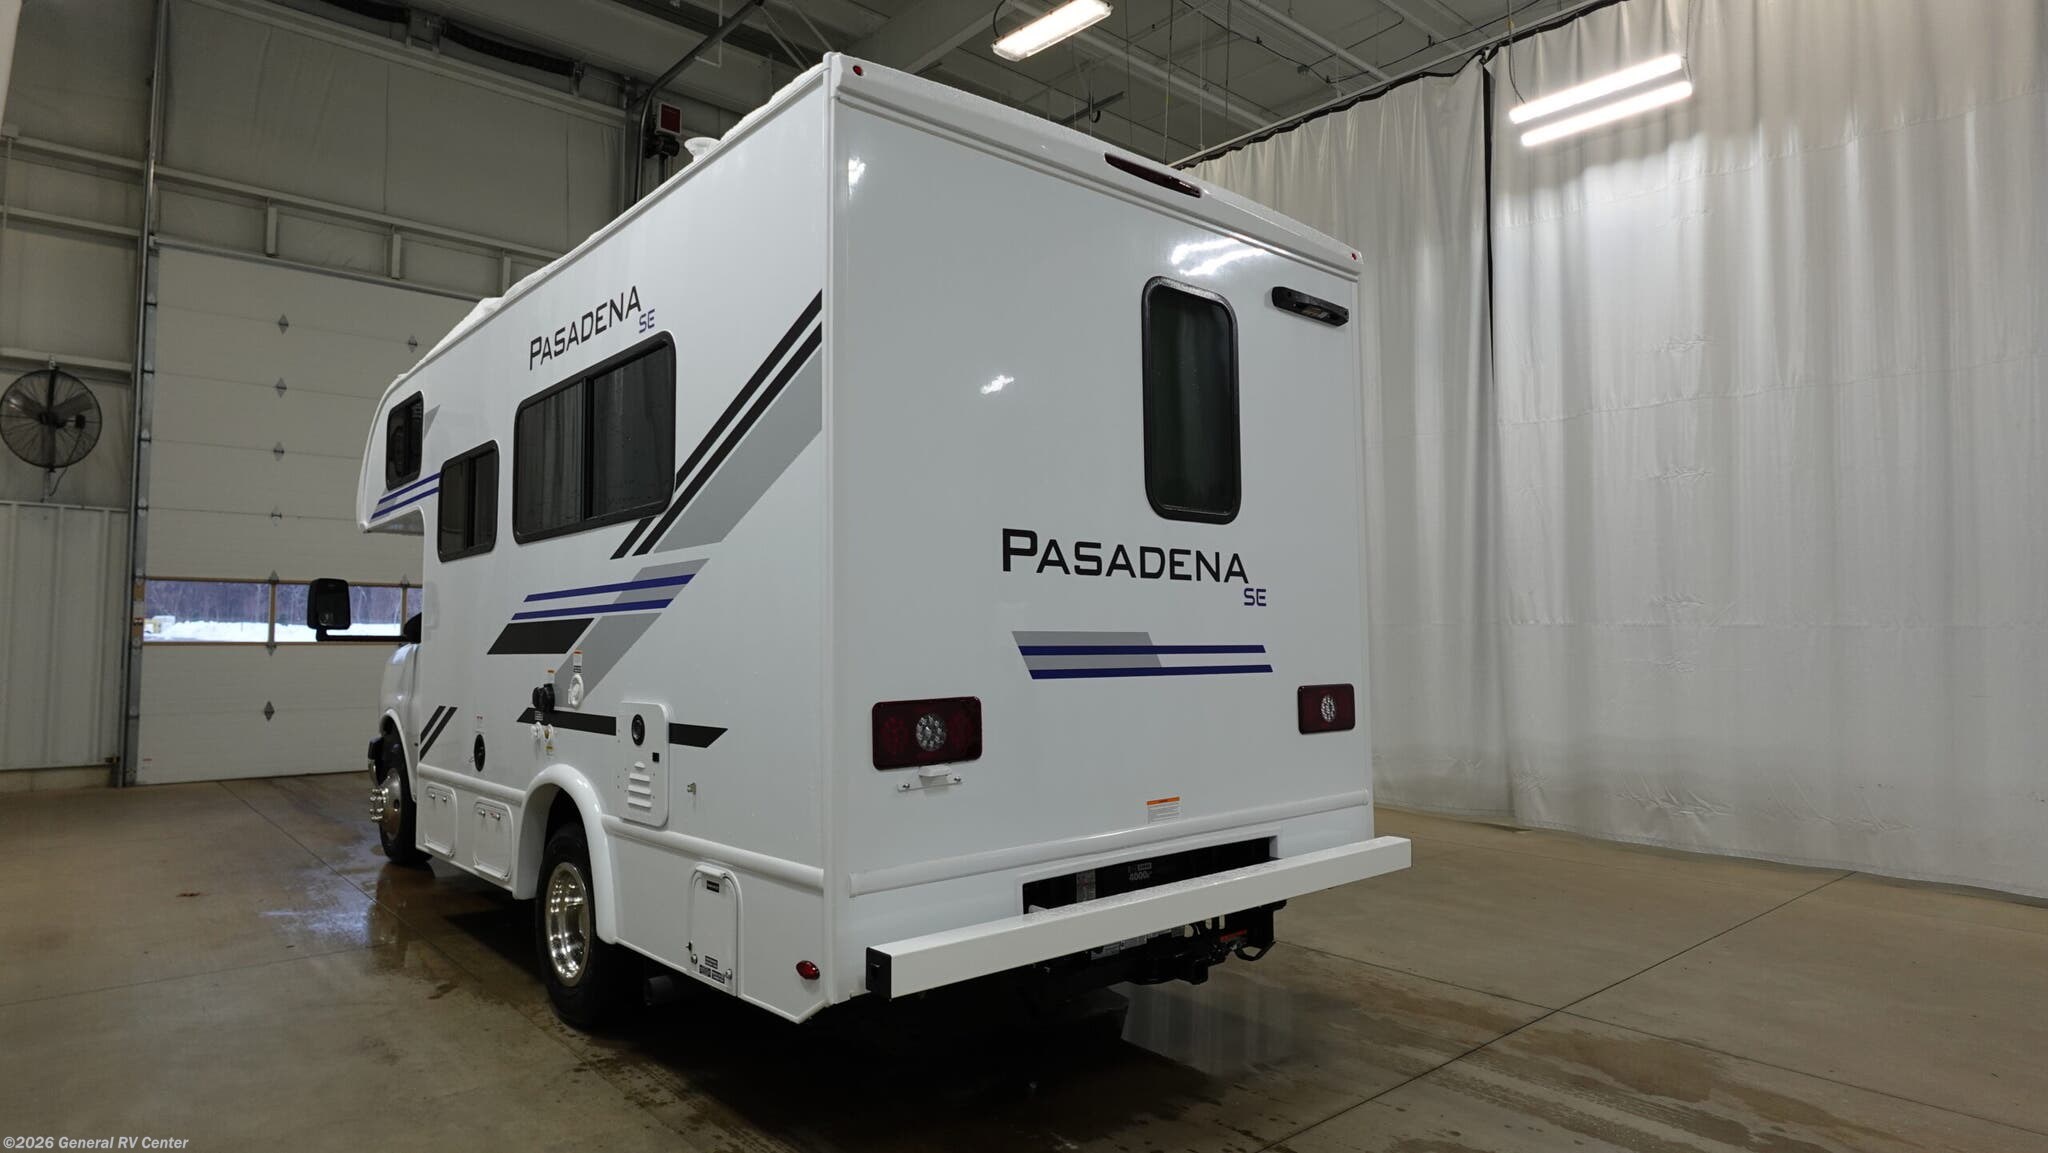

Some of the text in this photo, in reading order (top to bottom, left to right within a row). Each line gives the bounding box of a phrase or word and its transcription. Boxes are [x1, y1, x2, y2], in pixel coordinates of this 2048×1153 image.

[529, 285, 642, 371] PASADENA
[638, 309, 656, 334] SE
[1002, 528, 1249, 584] PASADENA
[1243, 587, 1267, 606] SE
